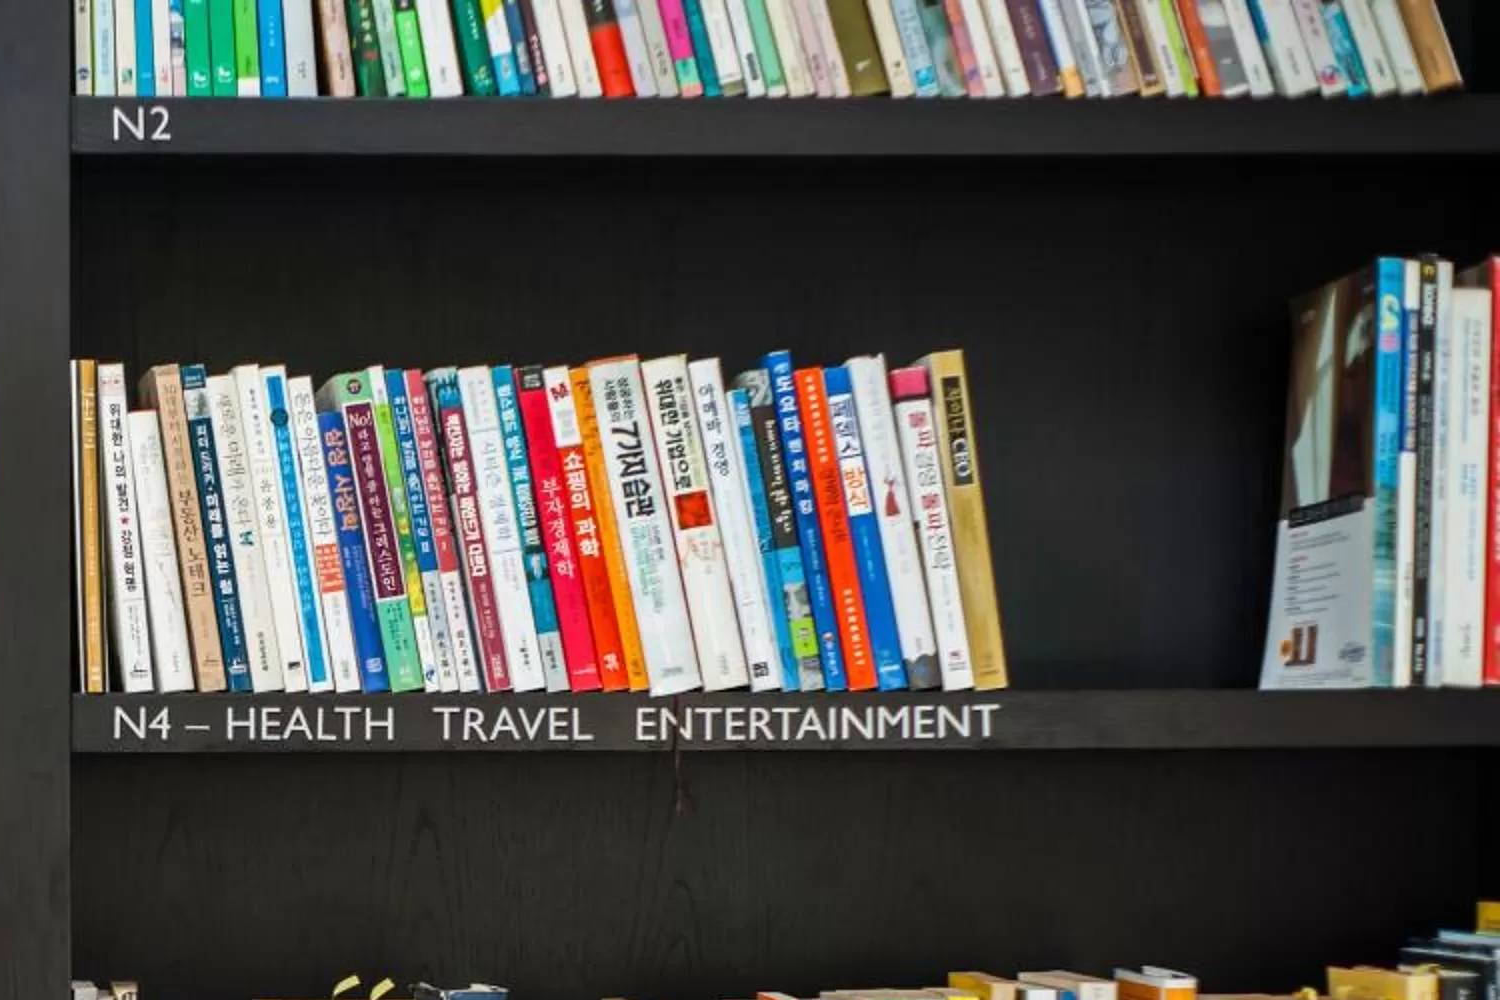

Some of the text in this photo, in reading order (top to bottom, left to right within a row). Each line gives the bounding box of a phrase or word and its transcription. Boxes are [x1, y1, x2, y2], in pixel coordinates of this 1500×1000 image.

[113, 108, 170, 140] N2
[654, 379, 692, 491] 위대한 기업으로
[323, 428, 358, 532] 삼성 사장학
[610, 422, 655, 518] 7가지 습관
[577, 518, 599, 558] 과학
[114, 704, 1000, 741] N4 HEALTH TRAVEL ENTERTAINMENT
